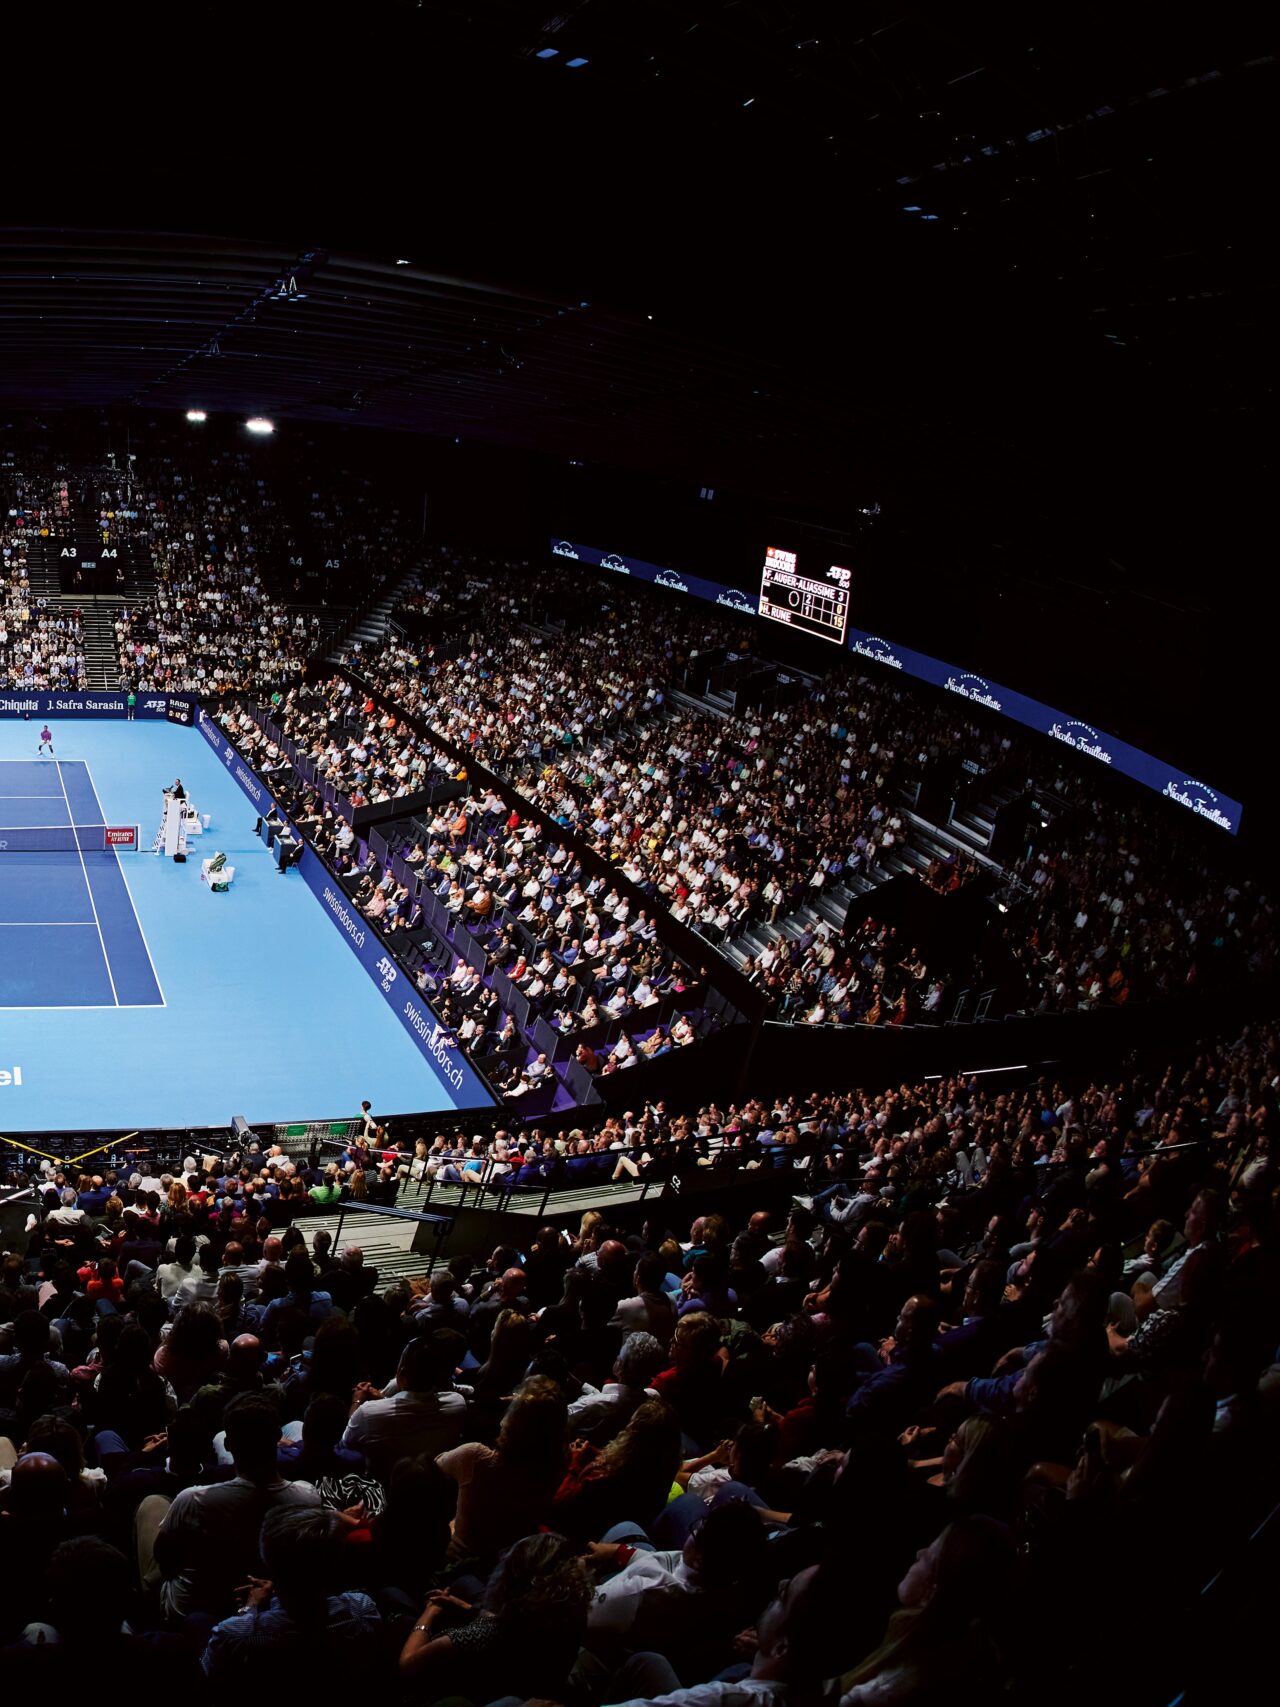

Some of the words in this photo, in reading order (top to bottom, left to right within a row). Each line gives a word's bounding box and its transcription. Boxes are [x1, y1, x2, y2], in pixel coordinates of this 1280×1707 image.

[60, 547, 77, 557] A3
[101, 548, 118, 558] A4
[289, 556, 303, 566] A4
[325, 559, 340, 569] A5
[773, 572, 836, 600] AUGER-ALIASSIME
[838, 591, 844, 602] 3
[806, 595, 811, 604] 2
[771, 607, 792, 622] RUNE
[805, 606, 809, 616] 1
[834, 616, 844, 627] 15
[852, 641, 874, 659] Nicolas
[866, 637, 891, 650] CHAMPAGNE
[944, 677, 969, 697] Nicolas
[960, 674, 989, 690] CHAMPAGNE
[47, 700, 55, 711] J.
[56, 700, 84, 710] Safra
[85, 700, 124, 710] Sarasin
[143, 701, 166, 709] ATP
[169, 699, 190, 709] RADO
[1067, 721, 1098, 739] CHAMPAGNE
[1048, 723, 1076, 747] Nicolas
[1076, 736, 1112, 764] Feuillatte
[1183, 780, 1218, 803] CHAMPAGNE
[1162, 782, 1193, 809] Nicolas
[1193, 798, 1232, 830] Feuillatte
[323, 887, 365, 949] swissindoors.ch
[375, 956, 397, 983] ATP
[380, 979, 391, 993] 500
